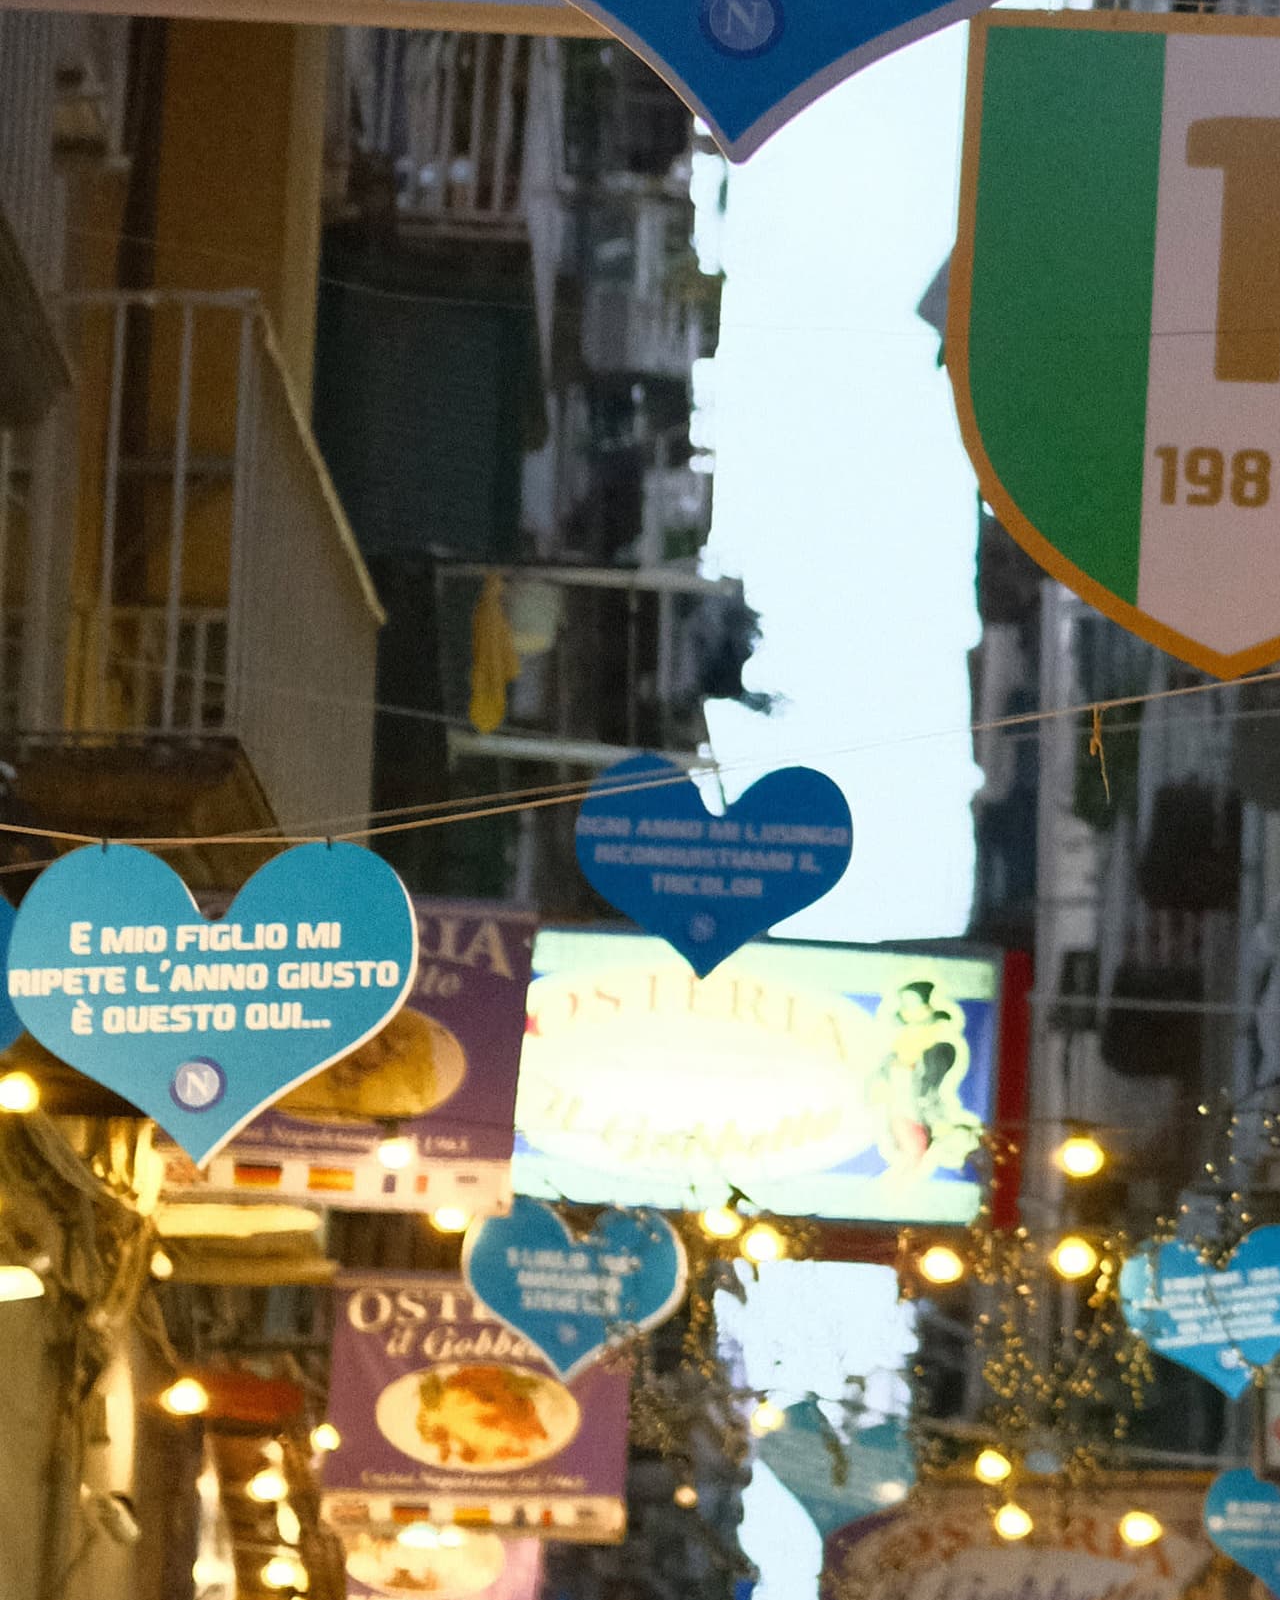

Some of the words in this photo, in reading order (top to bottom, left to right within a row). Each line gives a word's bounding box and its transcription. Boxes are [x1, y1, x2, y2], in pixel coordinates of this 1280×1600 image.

[725, 1, 760, 34] N
[69, 922, 92, 954] E
[101, 926, 167, 954] MIO
[176, 923, 287, 952] FIGLIO
[296, 922, 341, 949] MI
[8, 967, 126, 997] RIPETE
[135, 960, 268, 994] L'ANNO
[278, 960, 399, 990] GIUSTO
[71, 1001, 93, 1035] È
[102, 1004, 236, 1034] QUESTO
[244, 1002, 331, 1031] QUI...
[185, 1072, 210, 1097] N
